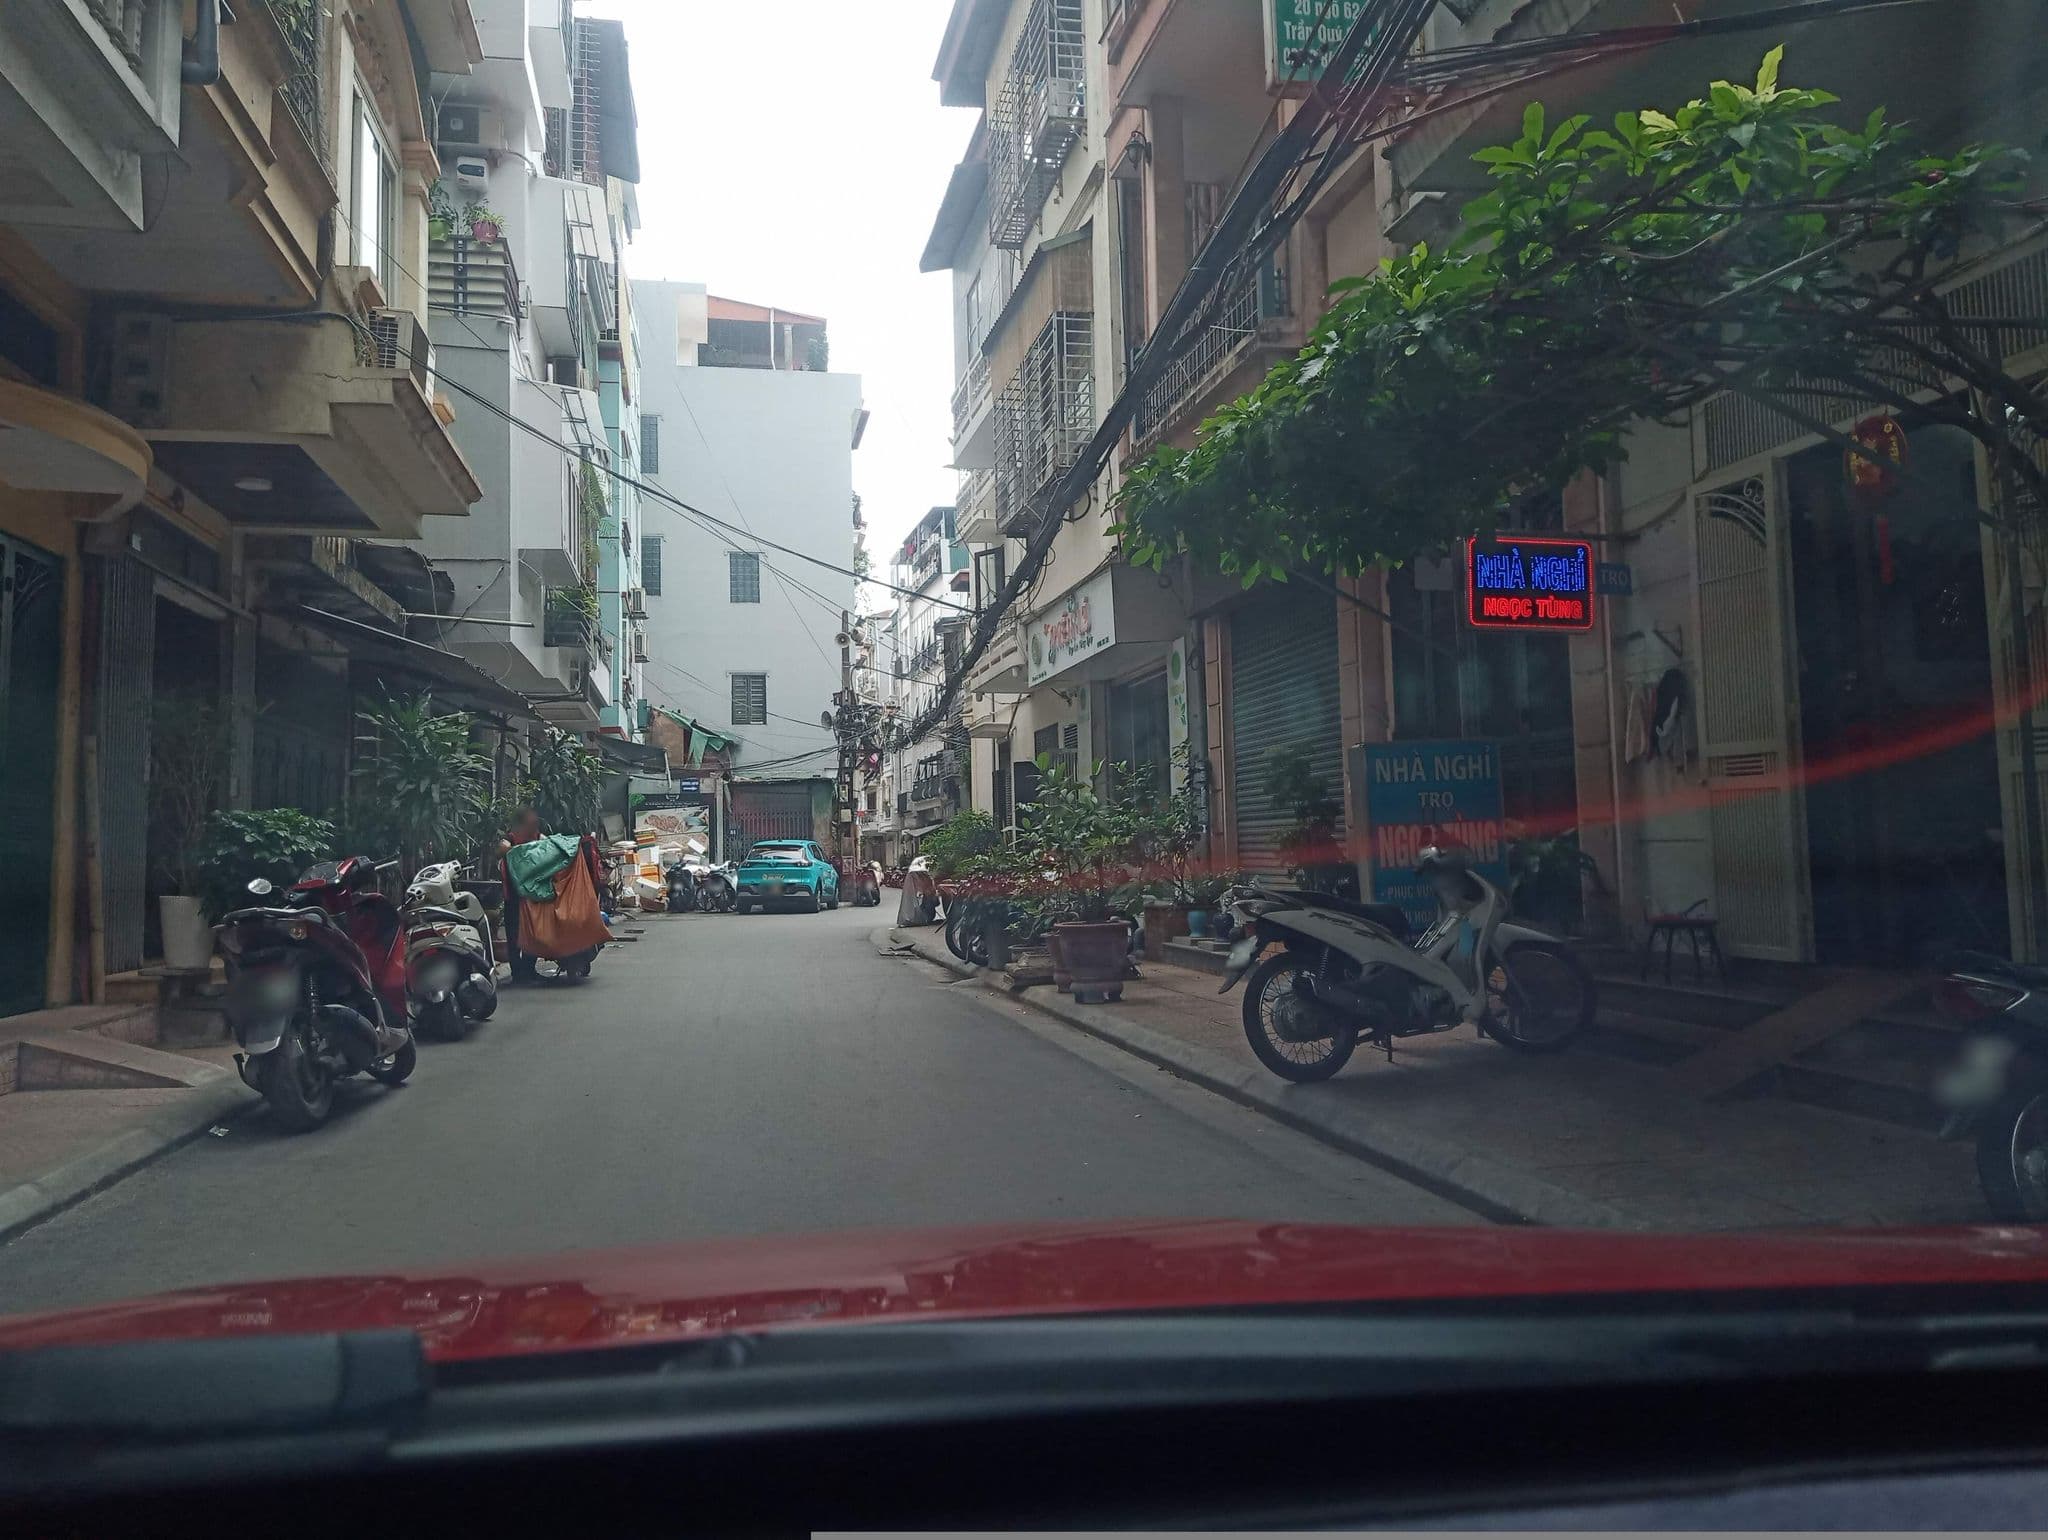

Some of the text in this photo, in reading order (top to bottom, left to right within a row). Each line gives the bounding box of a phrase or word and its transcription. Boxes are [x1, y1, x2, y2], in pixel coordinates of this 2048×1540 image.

[1294, 0, 1311, 15] 20
[1477, 546, 1586, 592] NHÀ NGHỈ
[1483, 594, 1583, 621] NGỌC TÙNG
[1376, 745, 1492, 783] NHÀ NGHỈ
